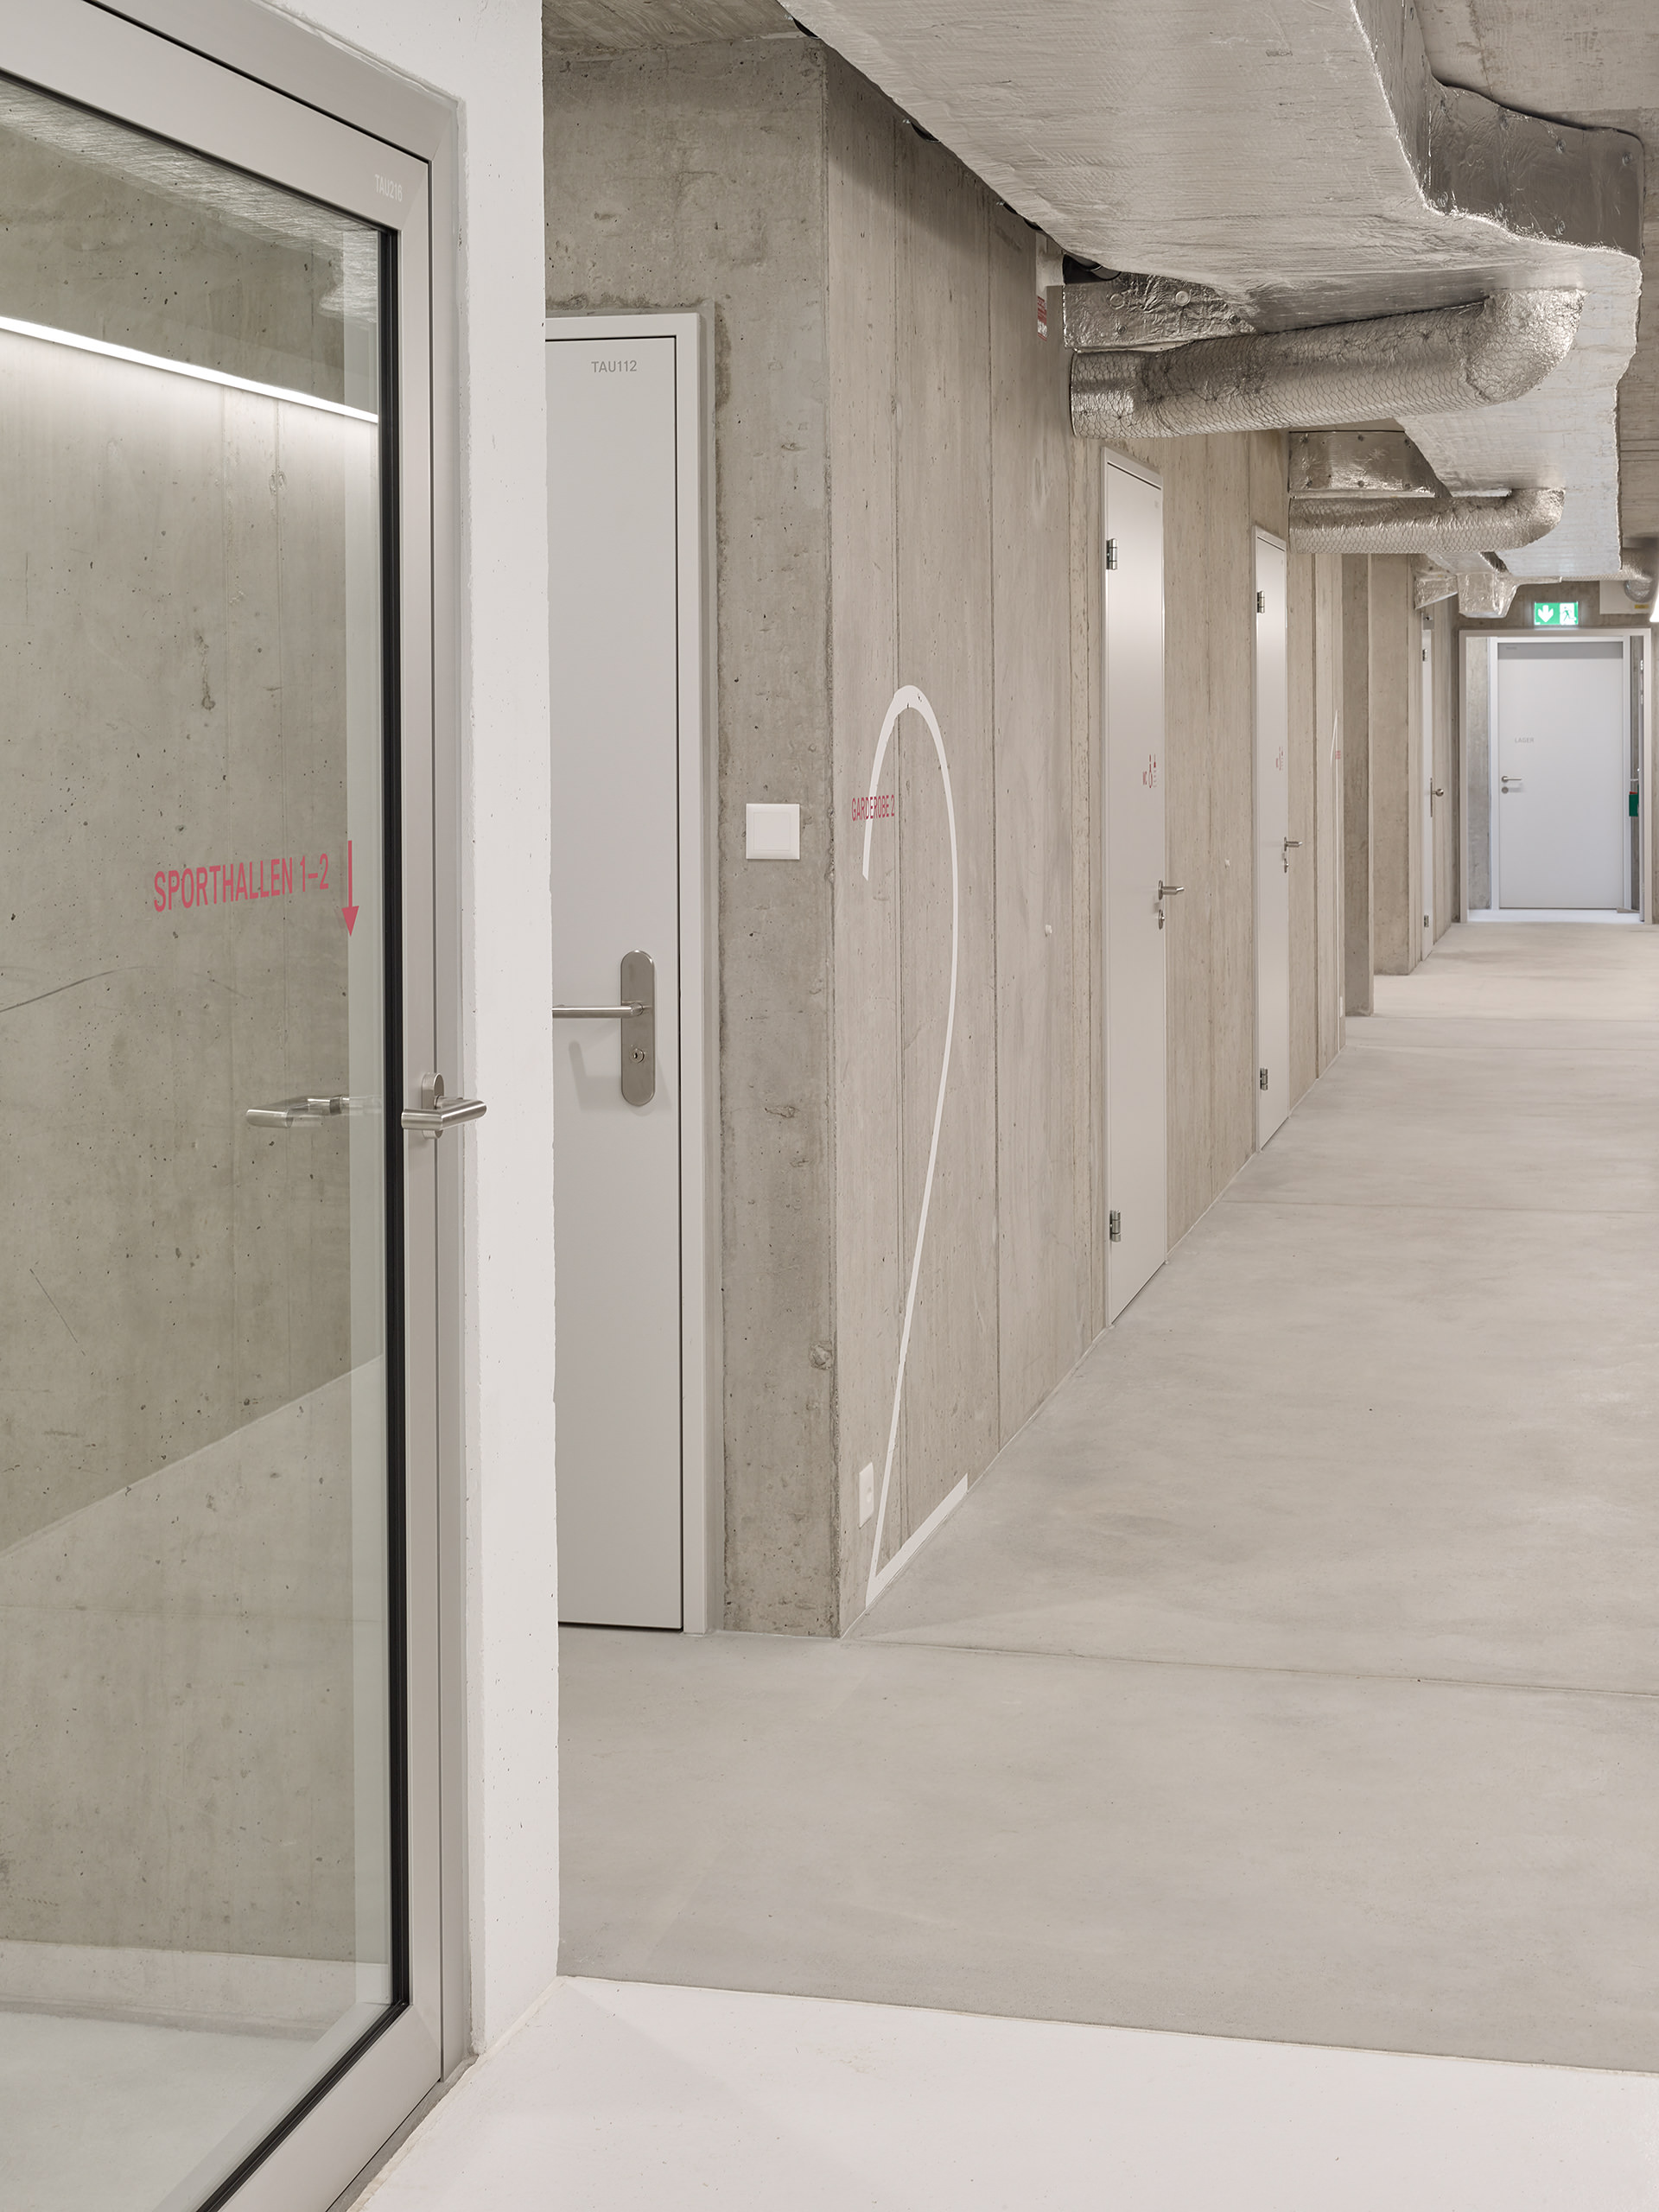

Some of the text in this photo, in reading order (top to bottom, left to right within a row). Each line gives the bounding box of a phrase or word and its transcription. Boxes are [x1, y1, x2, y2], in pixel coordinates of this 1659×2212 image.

[374, 174, 403, 202] TAU216
[591, 359, 637, 372] TAU112
[851, 794, 895, 821] GARDEROBE 2
[154, 856, 293, 912] SPORTHALLEN
